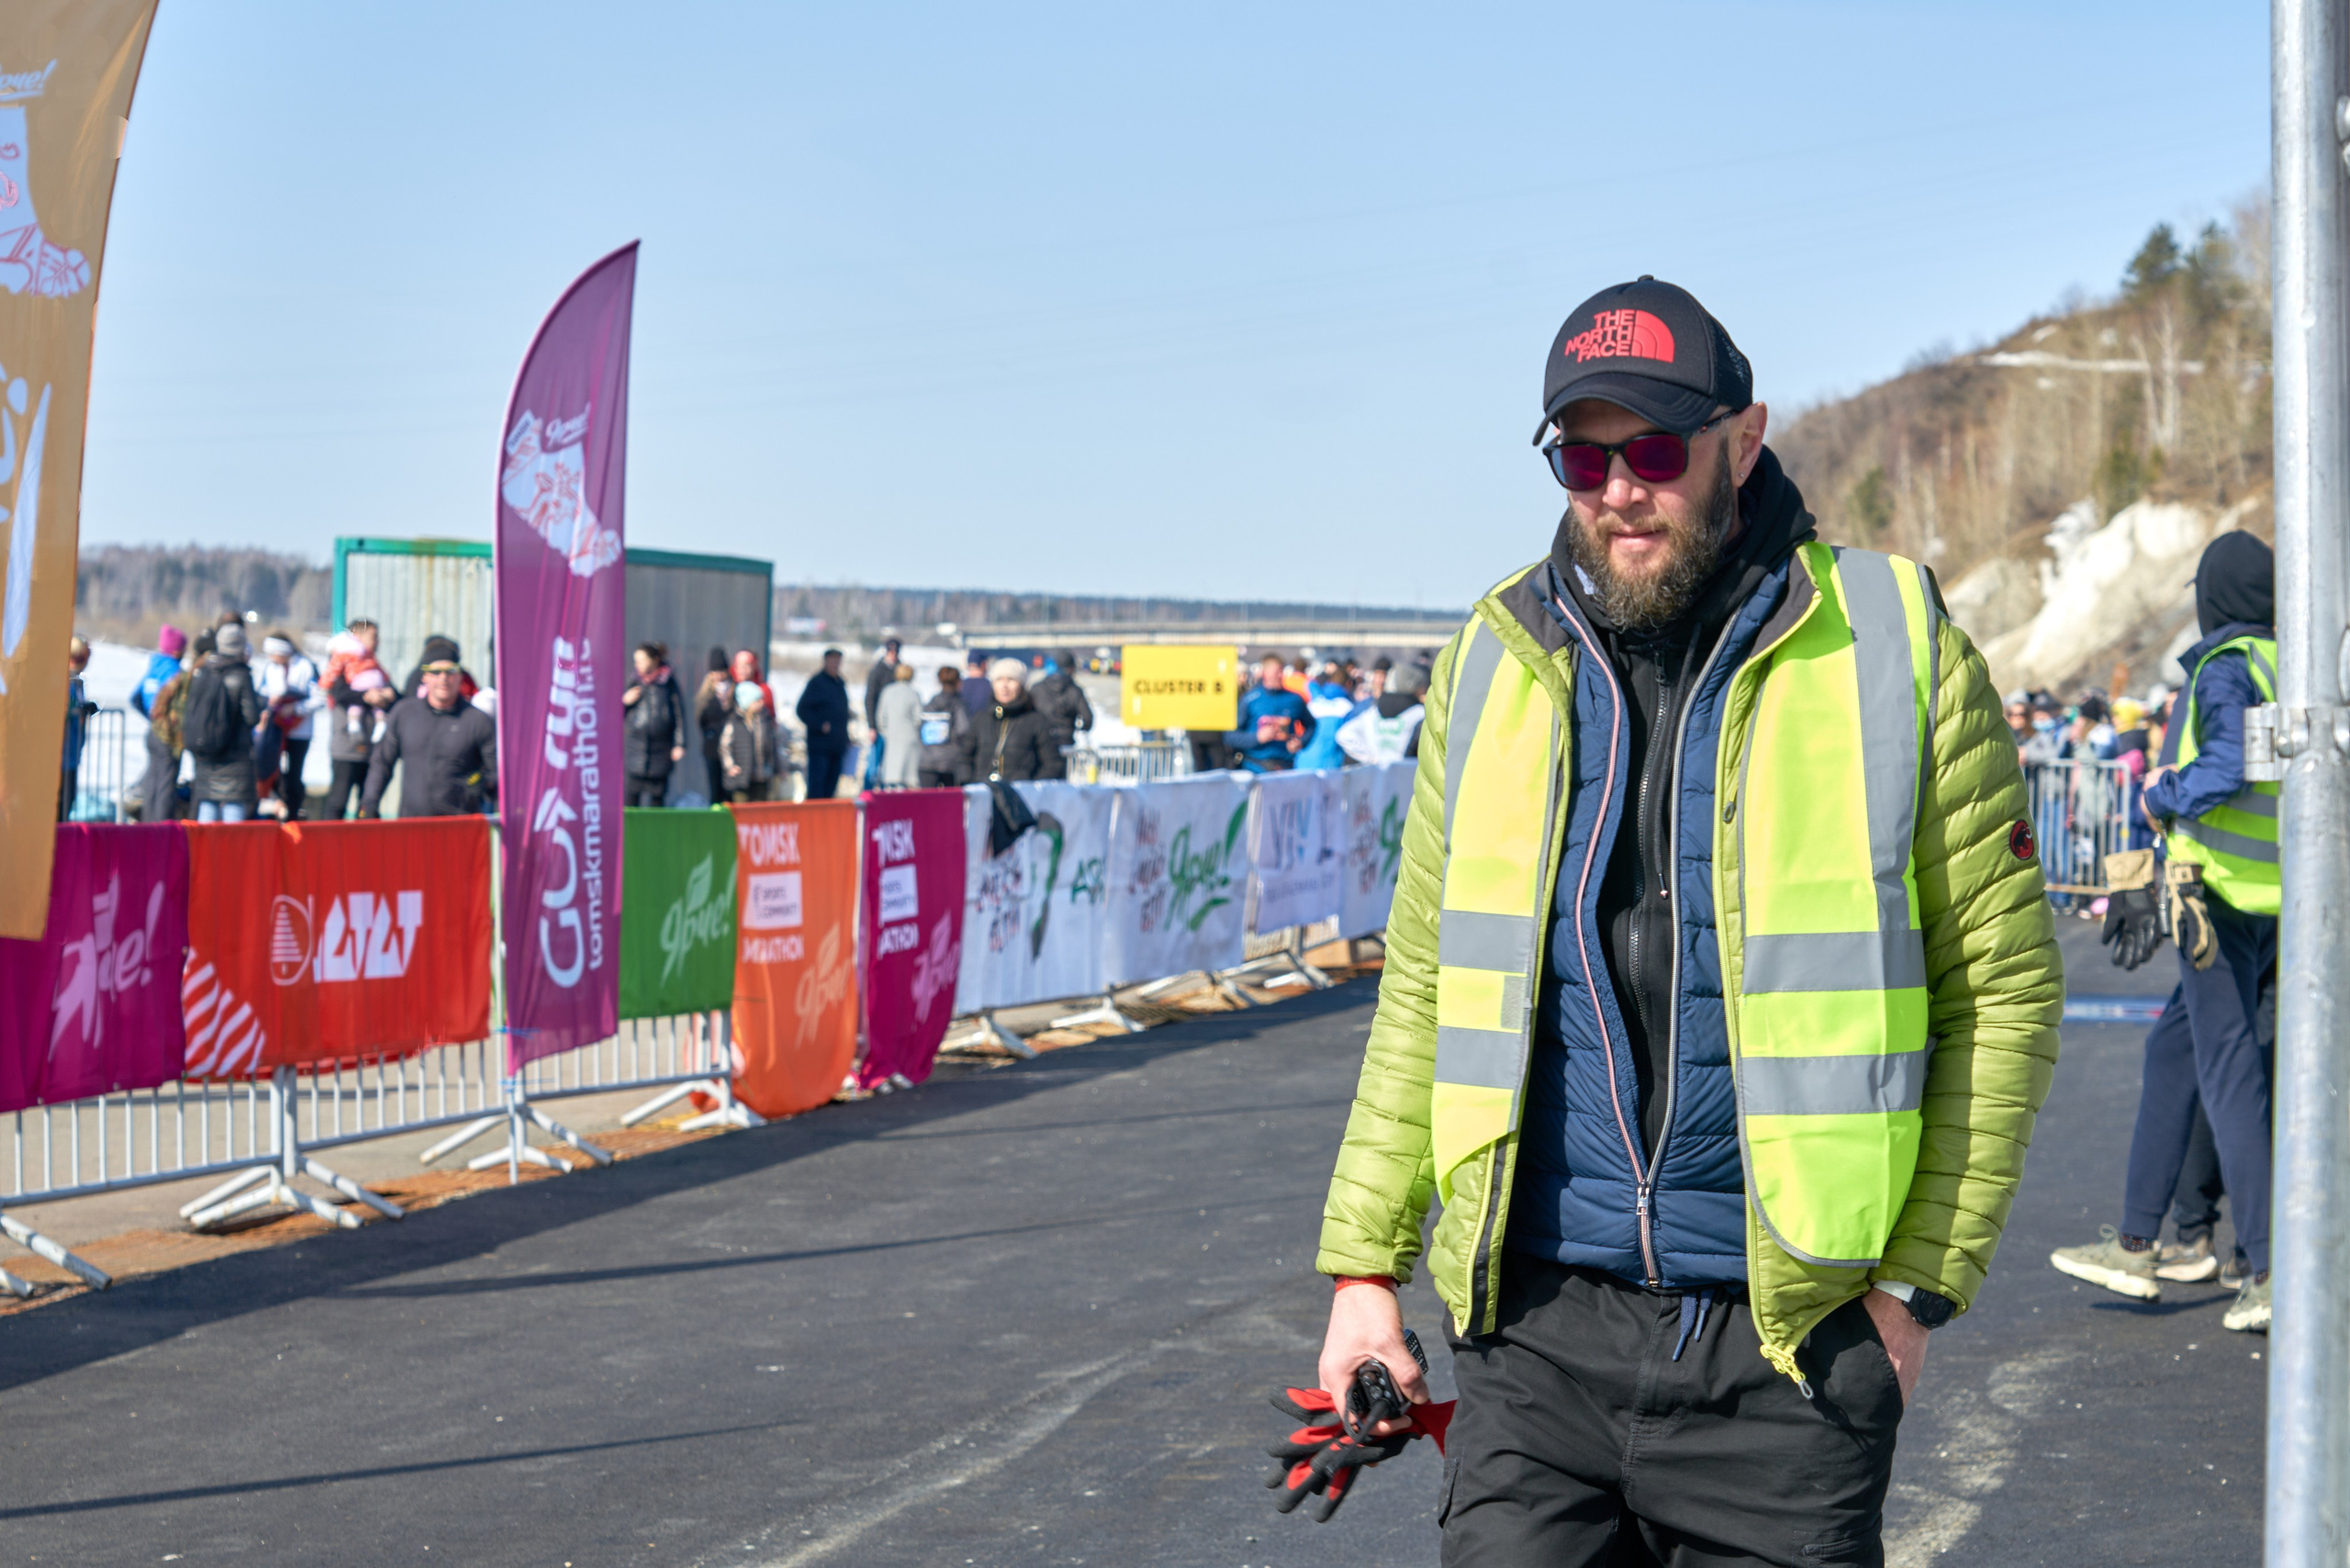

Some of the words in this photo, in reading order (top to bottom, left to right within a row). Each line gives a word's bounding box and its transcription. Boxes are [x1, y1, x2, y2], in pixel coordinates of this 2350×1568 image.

[1594, 308, 1635, 329] THE
[1564, 325, 1633, 356] NORTH
[1577, 340, 1631, 364] FACE
[1133, 678, 1205, 694] CLUSTER
[544, 634, 576, 771] run
[738, 823, 801, 866] TOMSK
